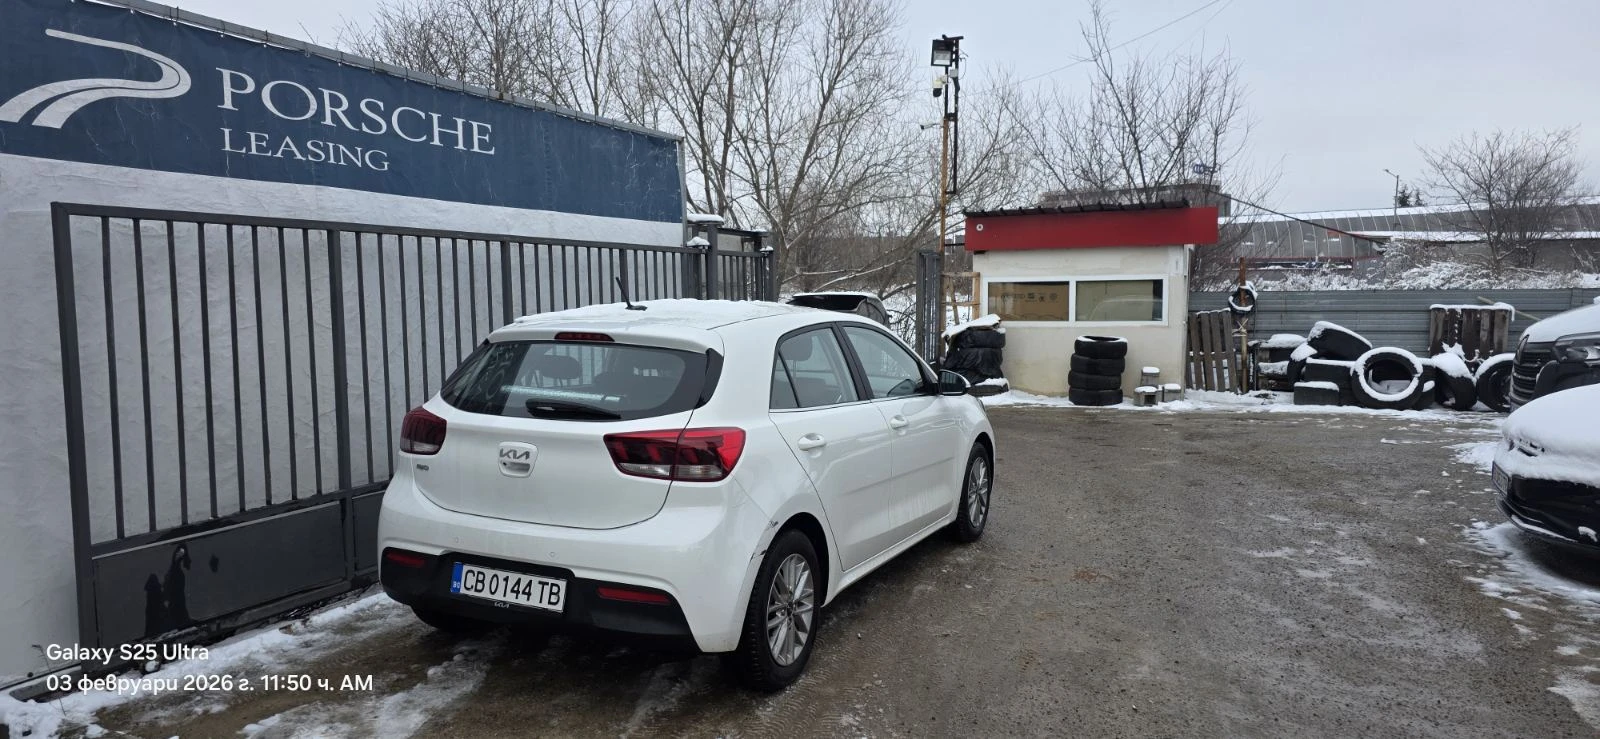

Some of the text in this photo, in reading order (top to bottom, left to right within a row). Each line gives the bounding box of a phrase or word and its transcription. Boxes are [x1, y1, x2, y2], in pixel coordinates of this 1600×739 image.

[216, 67, 495, 155] PORSCHE
[221, 128, 390, 171] LEASING
[499, 448, 530, 460] KIA
[463, 569, 561, 606] CB 0144 TB
